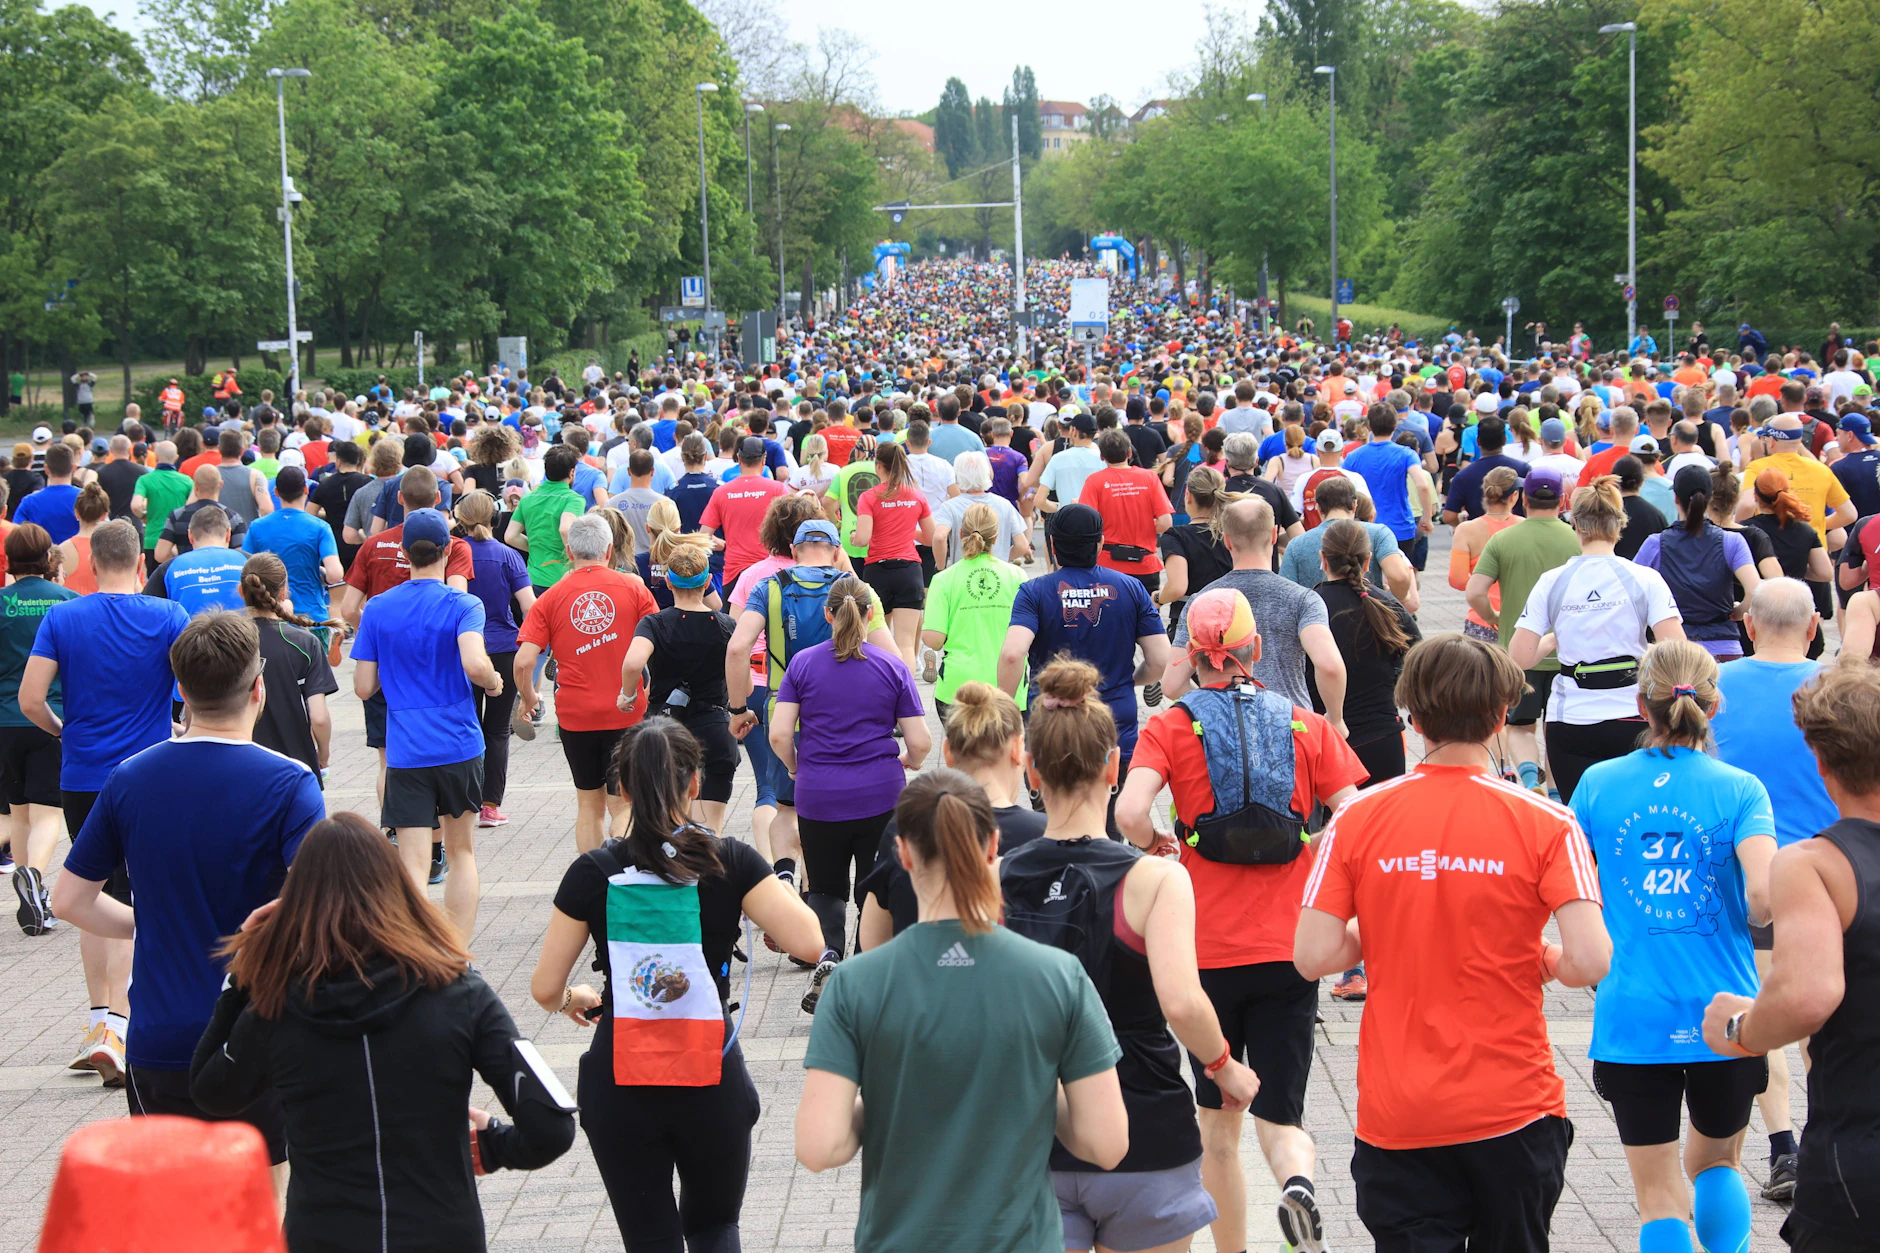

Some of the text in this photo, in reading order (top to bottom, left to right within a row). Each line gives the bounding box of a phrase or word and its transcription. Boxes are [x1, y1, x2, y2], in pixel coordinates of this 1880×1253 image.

[727, 492, 743, 500] Team
[881, 501, 896, 509] Team
[198, 575, 222, 583] Berlin
[575, 593, 607, 606] SIEGEN
[1061, 588, 1109, 598] #BERLIN
[1062, 599, 1091, 608] HALF
[1560, 604, 1590, 612] COSMO
[1592, 599, 1627, 609] CONSULT
[588, 609, 597, 617] SG
[573, 612, 613, 633] GIERSBERG
[788, 614, 798, 640] CAMELBAK
[576, 632, 618, 656] run is fun
[1614, 805, 1712, 856] HASPA MARATHON
[1641, 832, 1690, 860] 37.
[1642, 868, 1693, 895] 42K
[1621, 875, 1716, 919] HAMBURG 2023
[936, 957, 975, 967] adidas
